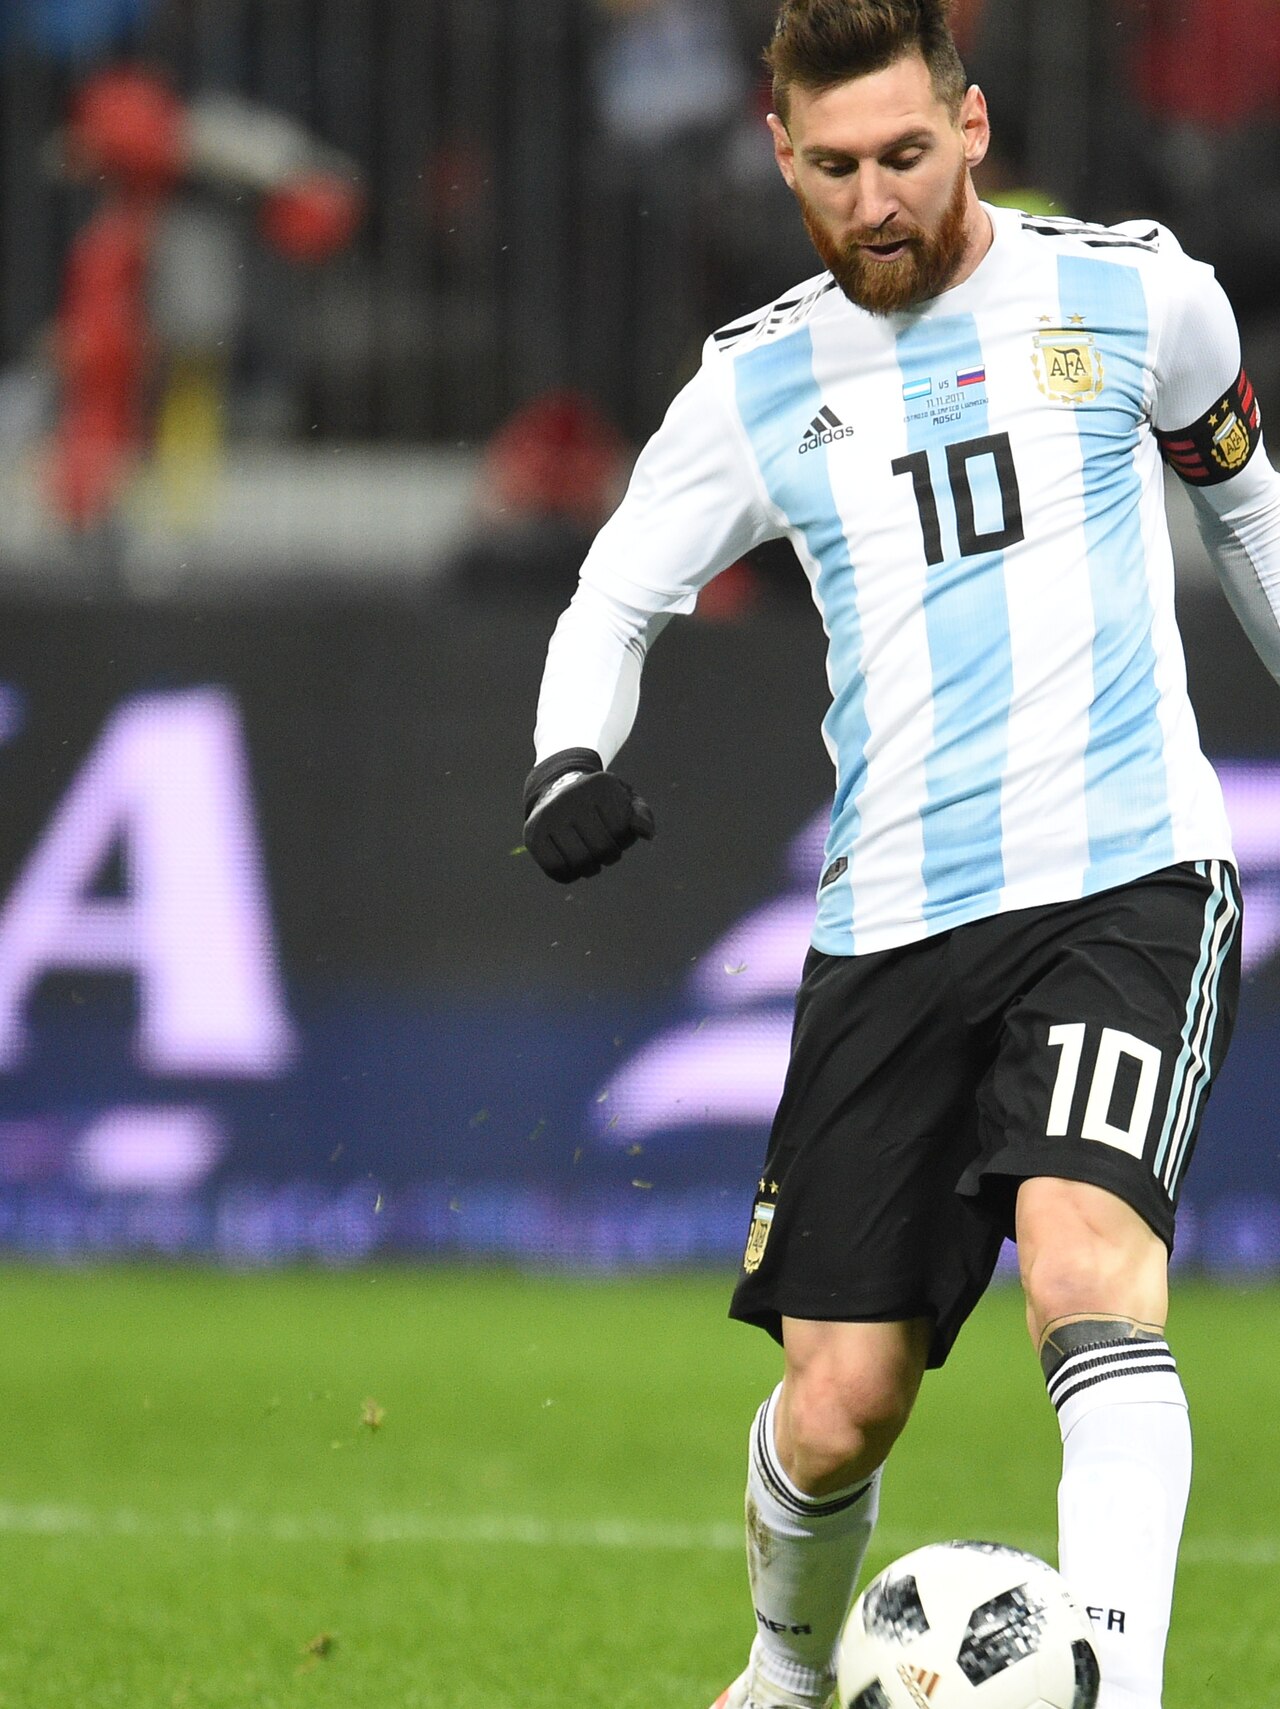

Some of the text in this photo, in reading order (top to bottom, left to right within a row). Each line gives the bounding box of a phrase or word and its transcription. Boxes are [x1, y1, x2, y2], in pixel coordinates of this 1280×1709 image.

[1050, 347, 1088, 383] AFA
[926, 392, 965, 408] 11.11.2017
[933, 412, 961, 425] MOSCU
[798, 426, 854, 454] adidas
[891, 431, 1025, 566] 10
[1046, 1023, 1162, 1160] 10
